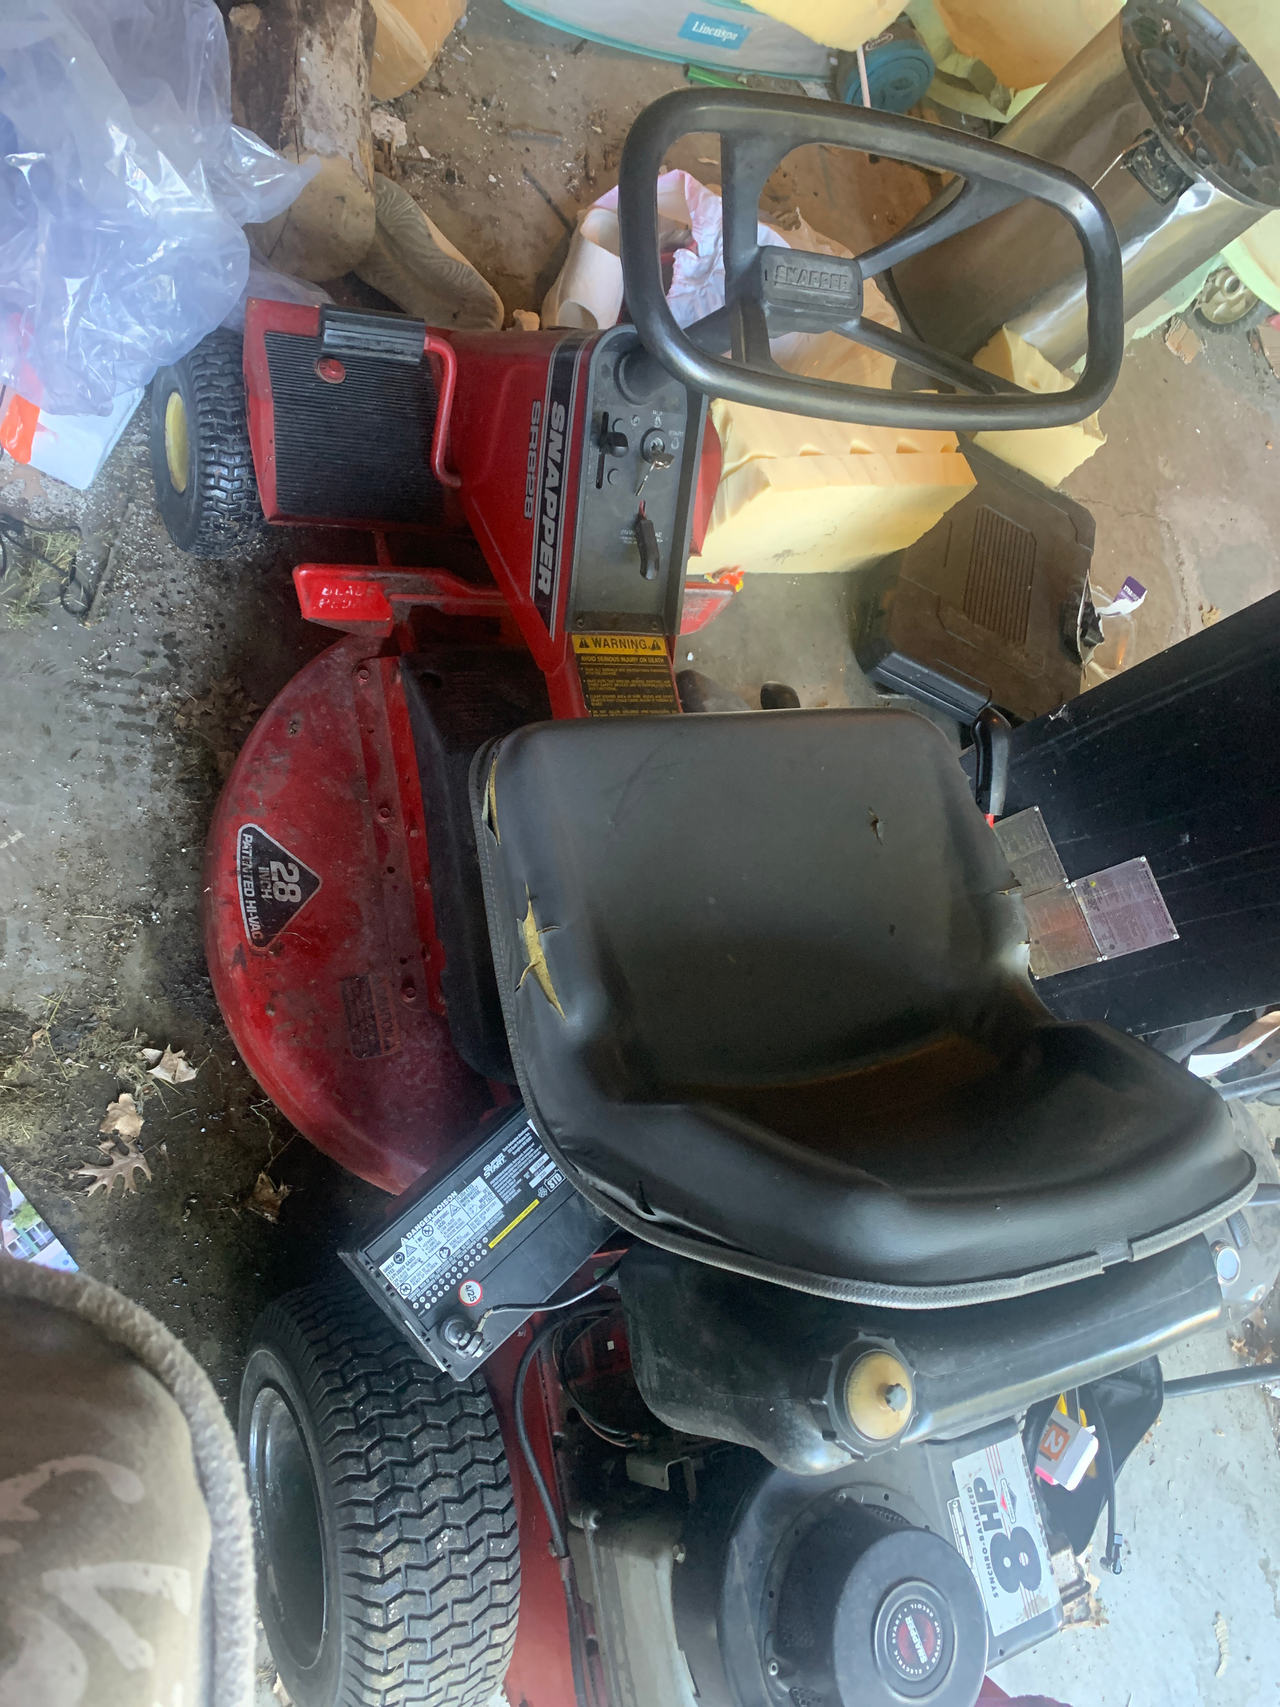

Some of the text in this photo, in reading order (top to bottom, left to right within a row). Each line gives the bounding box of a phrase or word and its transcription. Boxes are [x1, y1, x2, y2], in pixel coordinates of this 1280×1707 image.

[691, 20, 739, 42] Linenspa
[523, 400, 541, 521] SR828
[537, 400, 566, 595] SNAPPER
[592, 637, 647, 649] WARNING
[241, 833, 264, 940] PATENTED HI-VAC
[258, 866, 273, 900] INCH
[270, 860, 302, 903] 28
[546, 1172, 562, 1189] STD
[406, 1190, 458, 1240] DANGER/POISON
[465, 1284, 477, 1302] 4/25
[1044, 1430, 1064, 1453] 2
[973, 1477, 1003, 1532] HP
[966, 1486, 999, 1598] SYNCHRO-BALANCED
[990, 1526, 1042, 1593] 8
[905, 1615, 928, 1664] SNAPPER
